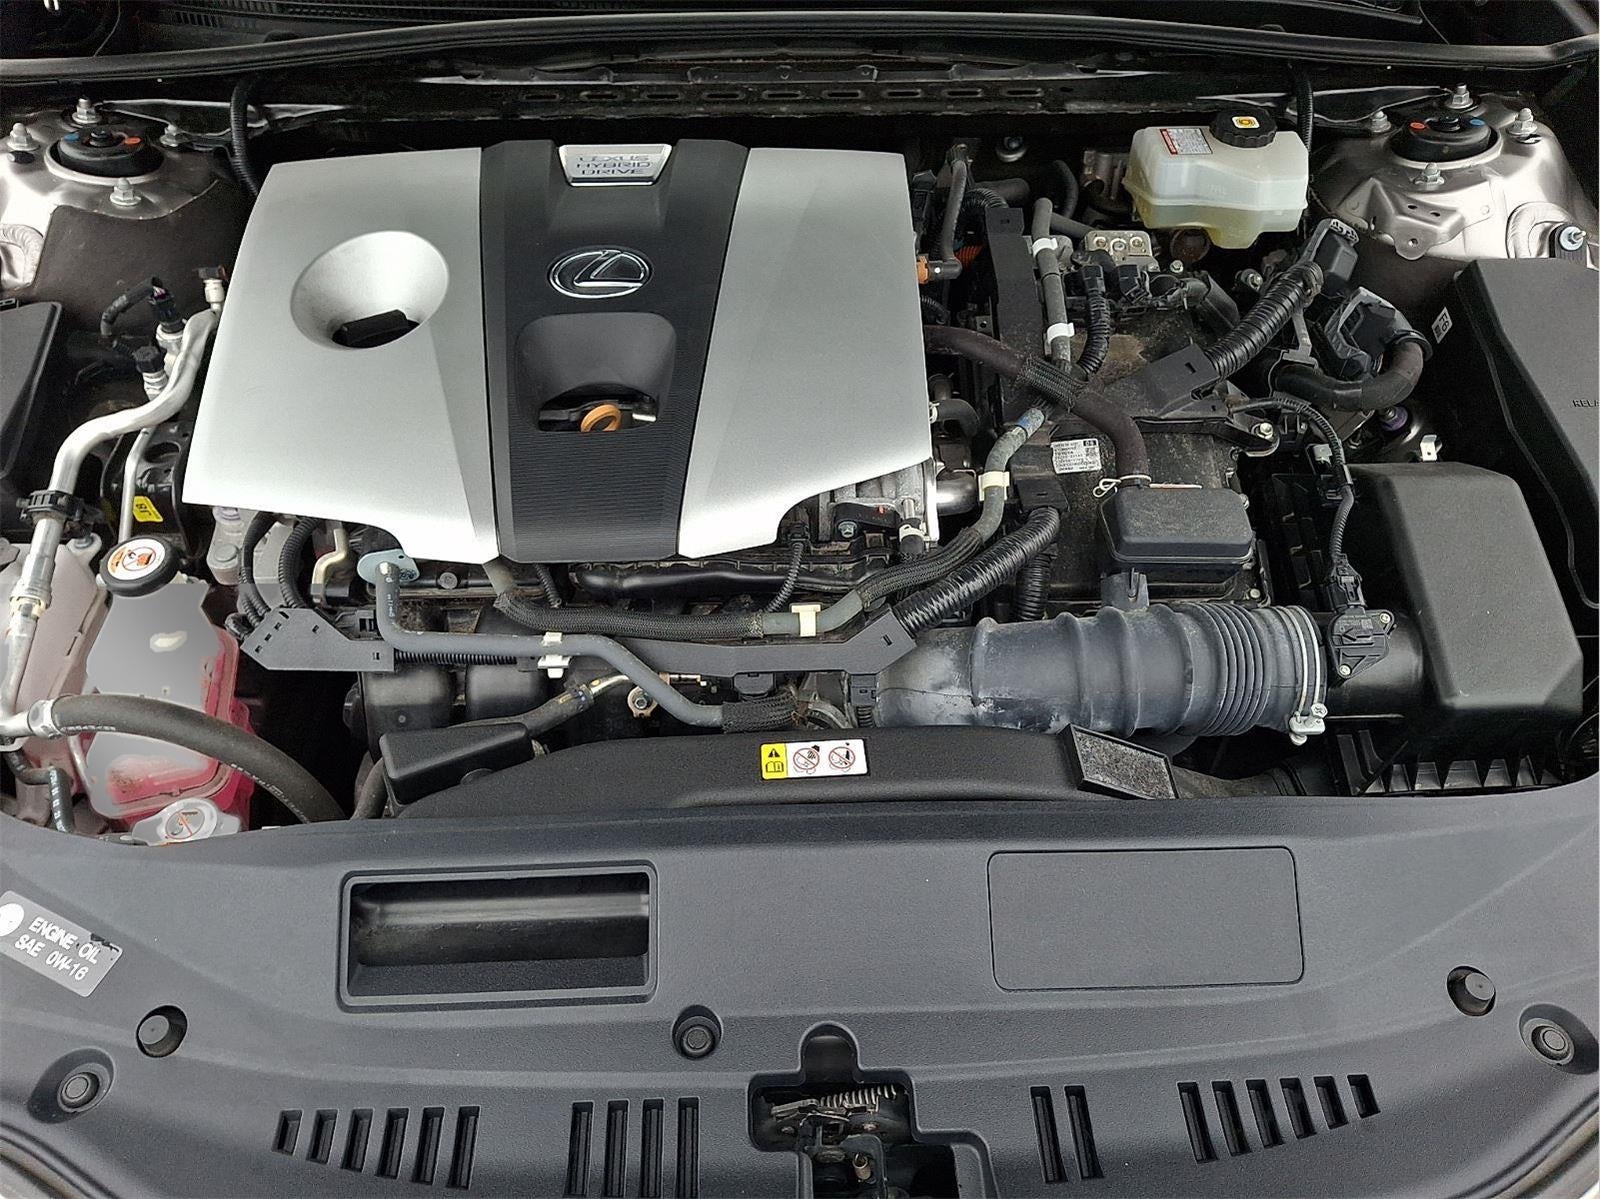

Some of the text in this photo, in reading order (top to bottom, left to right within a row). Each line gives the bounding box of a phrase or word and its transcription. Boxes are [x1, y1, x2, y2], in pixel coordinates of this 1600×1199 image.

[14, 934, 89, 981] SAE 0W-16
[28, 916, 100, 965] ENGINE OIL
